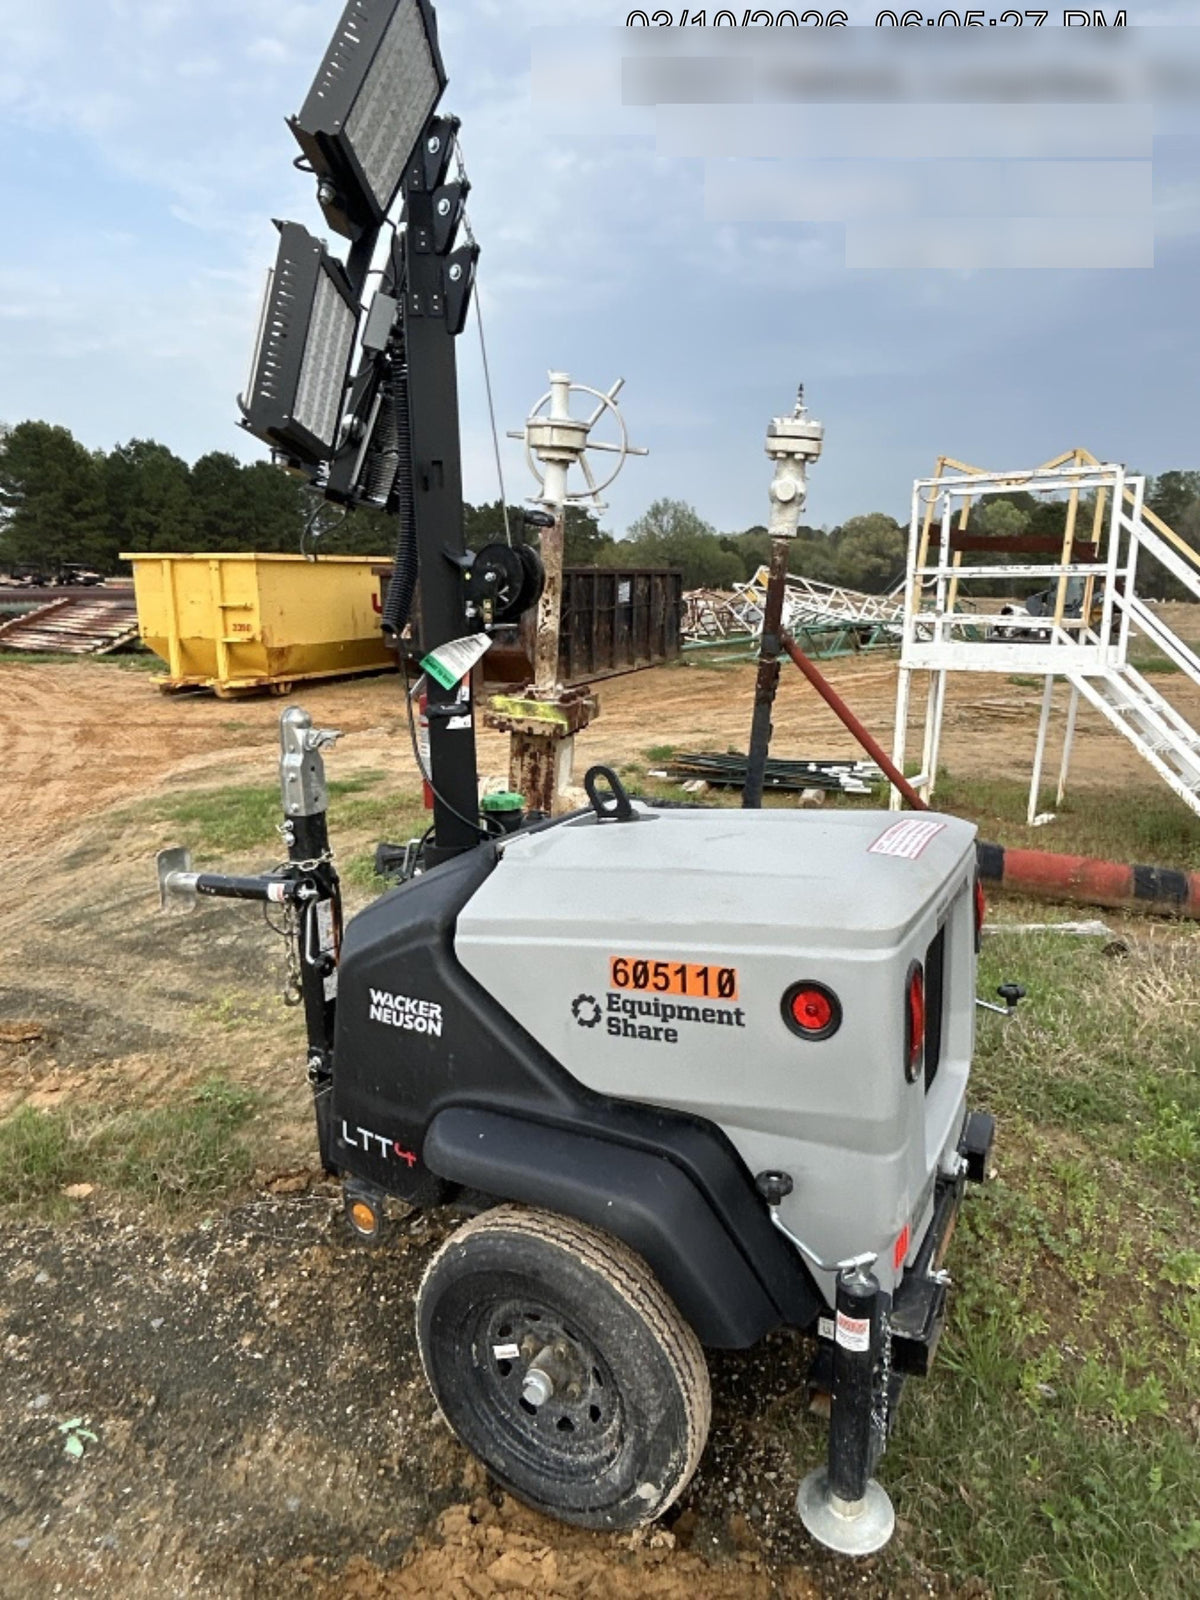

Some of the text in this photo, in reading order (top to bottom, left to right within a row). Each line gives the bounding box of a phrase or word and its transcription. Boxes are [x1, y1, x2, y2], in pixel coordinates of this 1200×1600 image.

[612, 957, 736, 999] 605110
[369, 988, 443, 1020] WACKER
[369, 1004, 443, 1037] NEUSON
[606, 992, 746, 1027] Equipment
[606, 1016, 679, 1044] Share
[342, 1120, 417, 1167] LTT4
